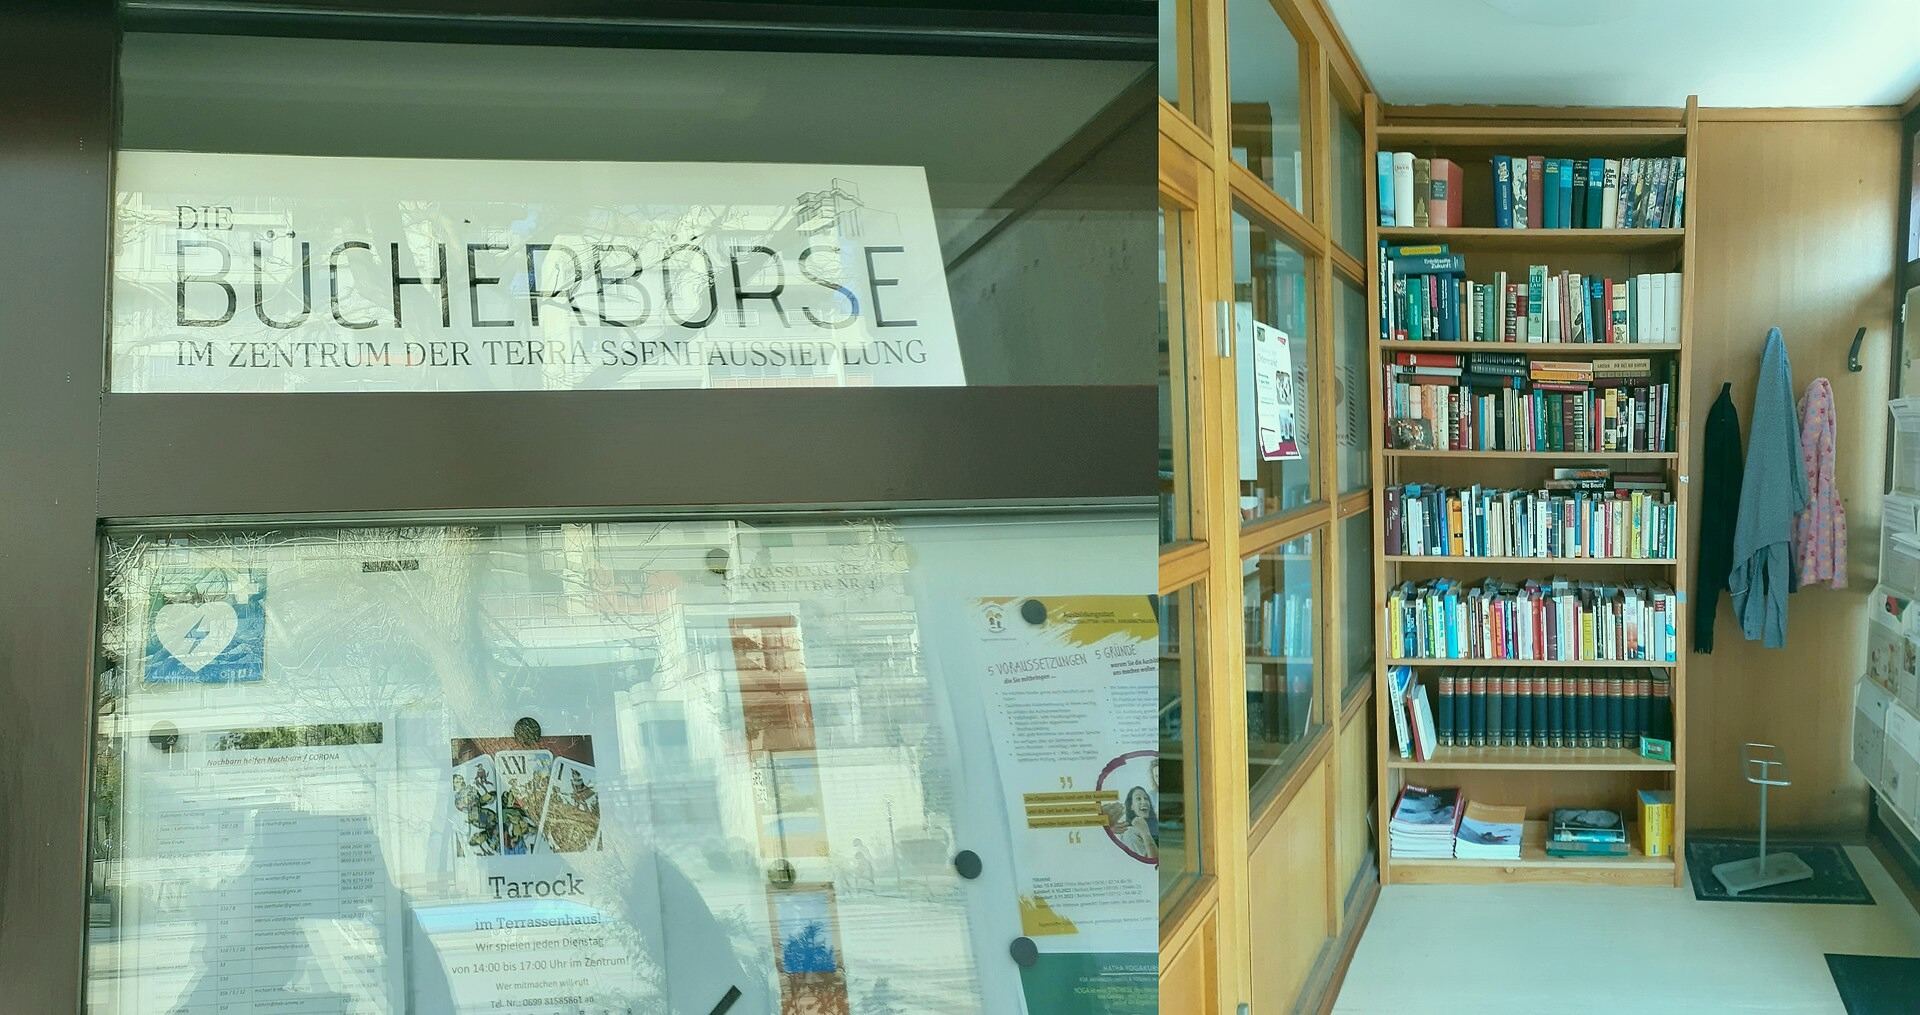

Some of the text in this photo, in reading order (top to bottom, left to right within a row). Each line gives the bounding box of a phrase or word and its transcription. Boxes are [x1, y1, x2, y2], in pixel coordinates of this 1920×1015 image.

[176, 205, 232, 231] DIE
[176, 229, 918, 329] BÜCHERBÖRSE
[176, 341, 214, 367] IM
[228, 341, 390, 367] ZENTRUM
[404, 341, 472, 367] DER
[1095, 643, 1137, 659] 5 GRÜNDE
[988, 653, 1088, 676] 5 VORAUSSETZUNGEN
[207, 758, 242, 766] Nachbarn
[243, 756, 266, 766] helfen
[267, 754, 302, 763] Nachbarn
[309, 753, 339, 761] CORONA
[500, 755, 527, 776] XXI
[488, 874, 584, 900] Tarock
[475, 912, 602, 931] im Terrassenhaus!
[476, 936, 604, 953] Wir spielen jeden Dienstag
[452, 956, 629, 974] von 14:00 bis 17:00 Uhr im Zentrum!
[496, 981, 513, 991] Wer
[514, 980, 557, 990] mitmachen
[523, 998, 542, 1007] 0699
